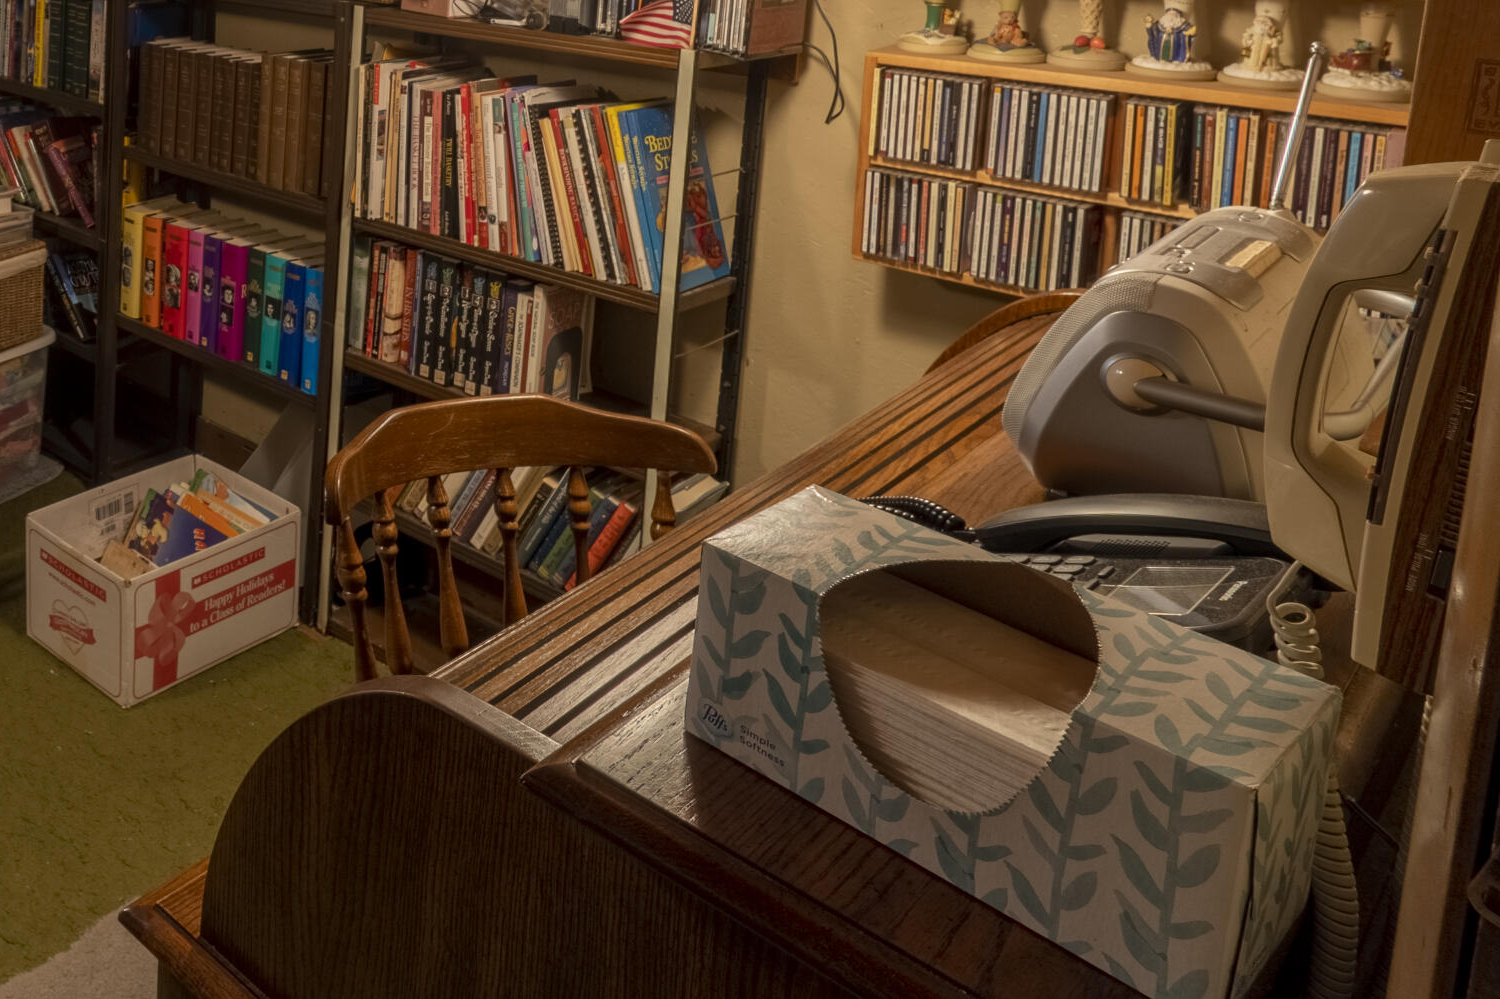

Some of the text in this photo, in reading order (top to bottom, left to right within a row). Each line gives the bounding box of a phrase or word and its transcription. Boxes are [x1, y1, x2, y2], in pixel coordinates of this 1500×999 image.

[411, 134, 420, 170] BASKET
[444, 159, 453, 188] BASKETRY
[548, 302, 581, 331] SOAP
[47, 553, 106, 600] SCHOLASTIC
[202, 549, 265, 582] SCHOLASTIC
[189, 621, 200, 633] to
[209, 606, 234, 624] Class
[235, 600, 246, 612] of
[246, 579, 286, 606] Readers!
[204, 572, 275, 611] Happy Holidays
[702, 703, 728, 731] Puffs
[739, 735, 785, 767] Softness
[740, 724, 776, 751] Simple
